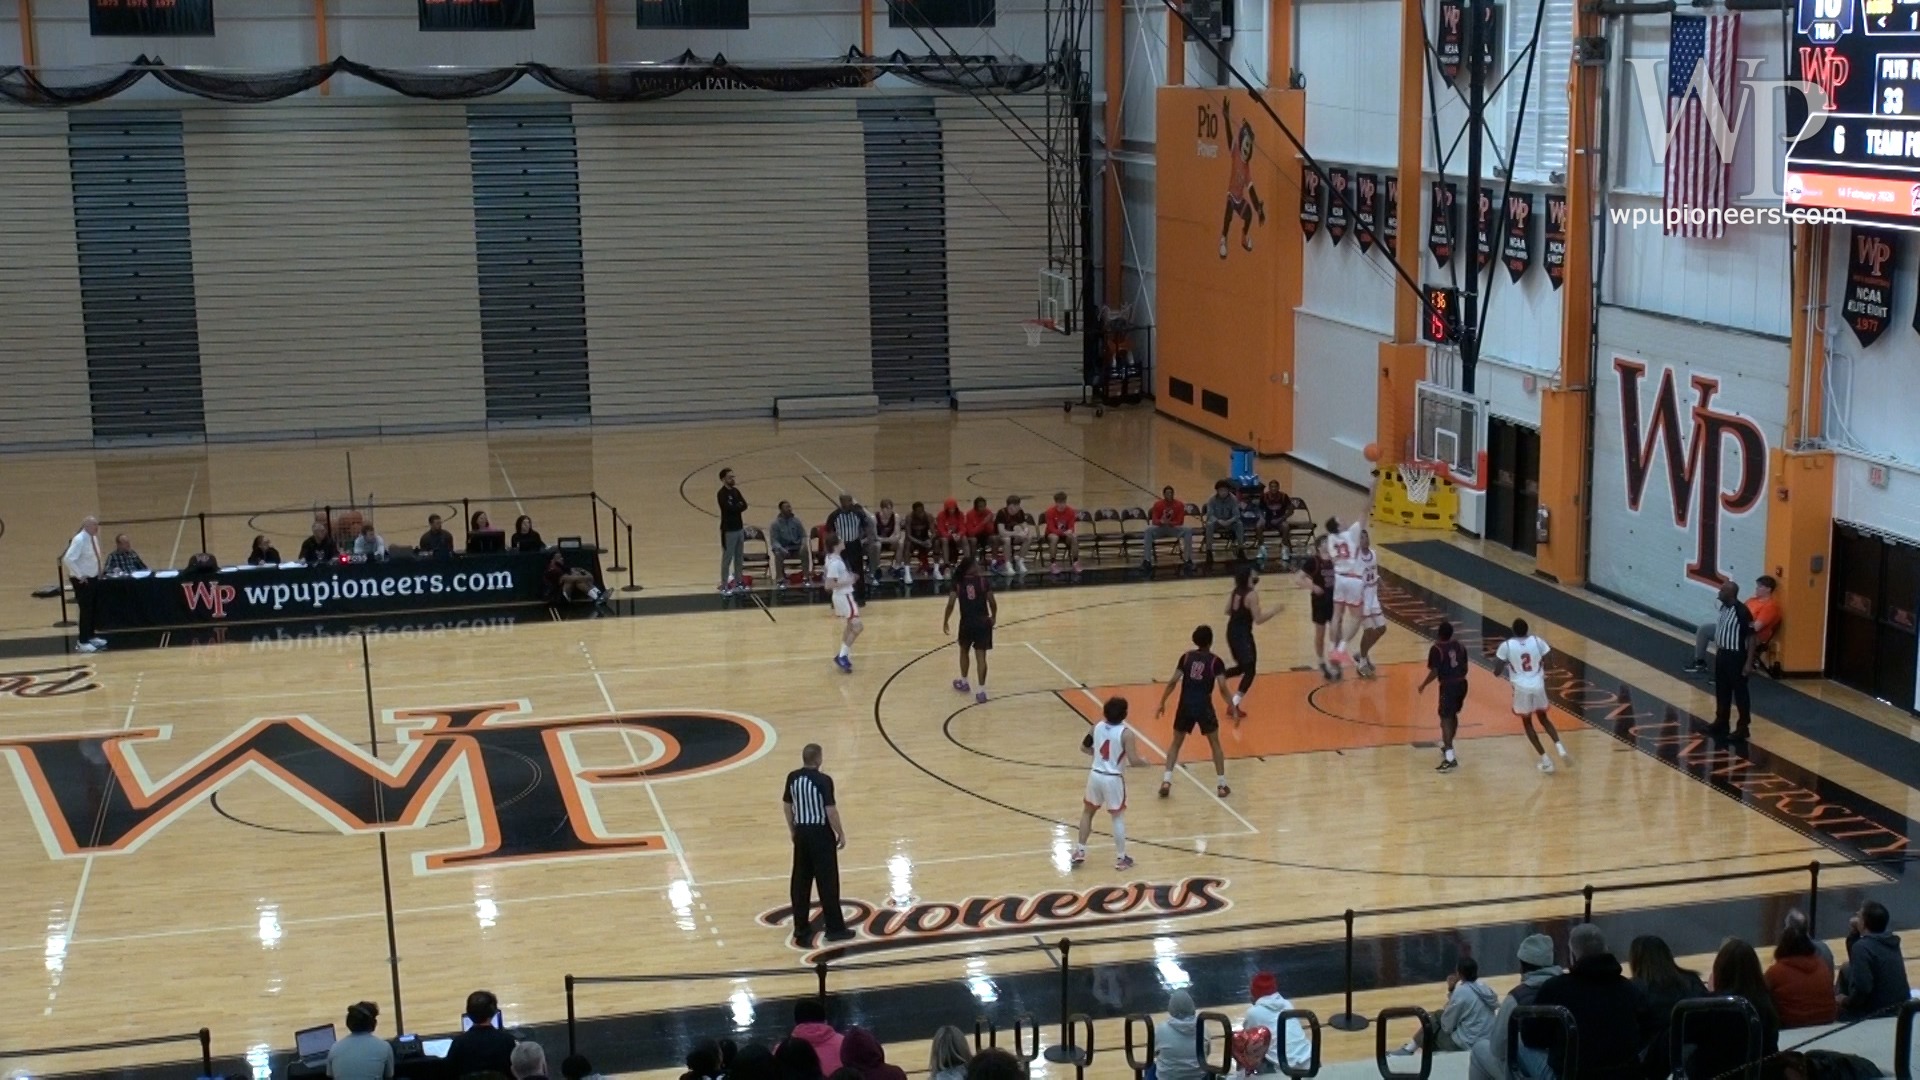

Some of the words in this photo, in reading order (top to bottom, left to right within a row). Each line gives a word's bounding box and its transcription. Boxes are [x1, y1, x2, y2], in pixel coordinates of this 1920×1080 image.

[1799, 47, 1849, 110] WP
[1197, 104, 1218, 140] Pio
[1833, 125, 1846, 154] 6
[1866, 129, 1904, 156] TEAM
[1857, 235, 1890, 276] WP
[1856, 287, 1882, 304] NCAA
[1856, 317, 1879, 332] 1977
[1612, 354, 1769, 591] WP
[180, 581, 236, 618] WP
[244, 571, 514, 609] wpupioneers.com
[1520, 652, 1532, 672] 2
[1099, 739, 1110, 762] 4
[0, 698, 778, 878] WP
[756, 876, 1231, 965] Pioneers
